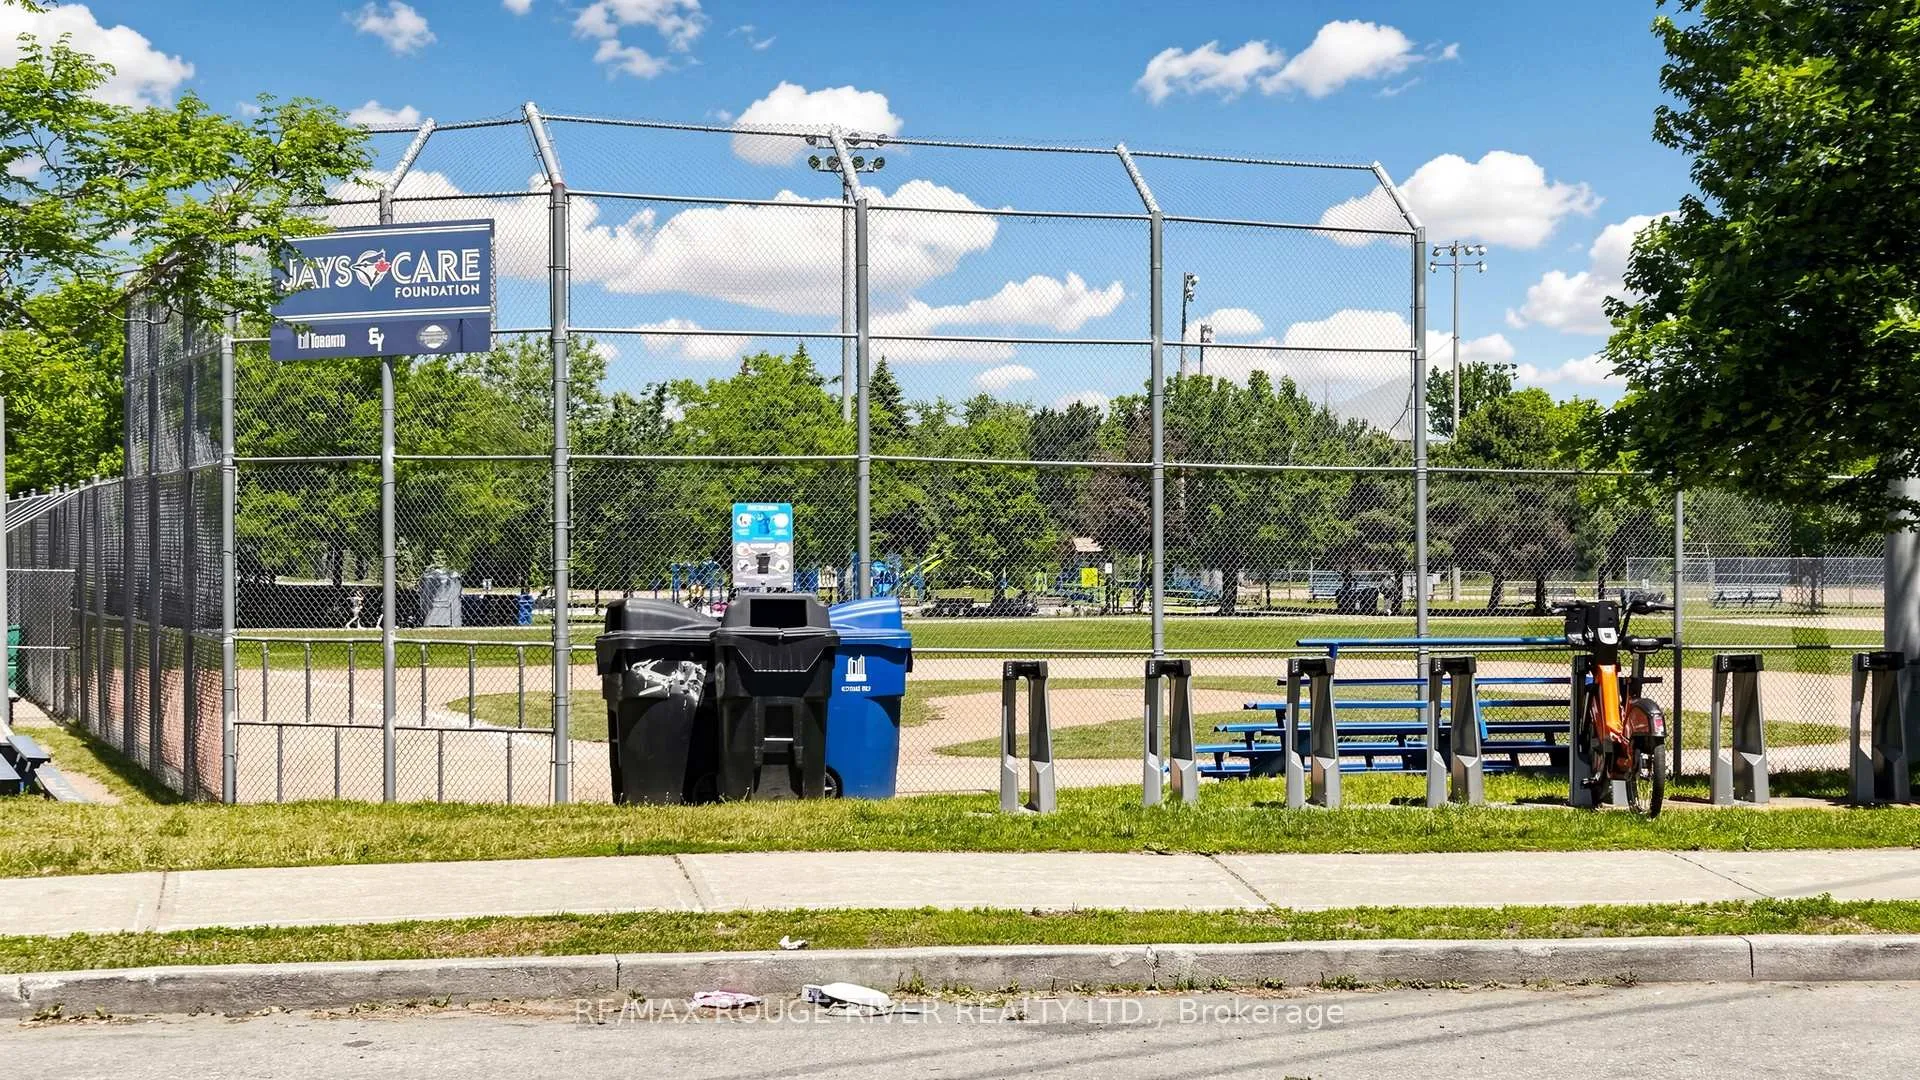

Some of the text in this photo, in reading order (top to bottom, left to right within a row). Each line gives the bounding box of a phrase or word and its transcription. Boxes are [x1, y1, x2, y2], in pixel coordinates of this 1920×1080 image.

[281, 248, 481, 289] JAYS CARE
[394, 284, 480, 299] FOUNDATION
